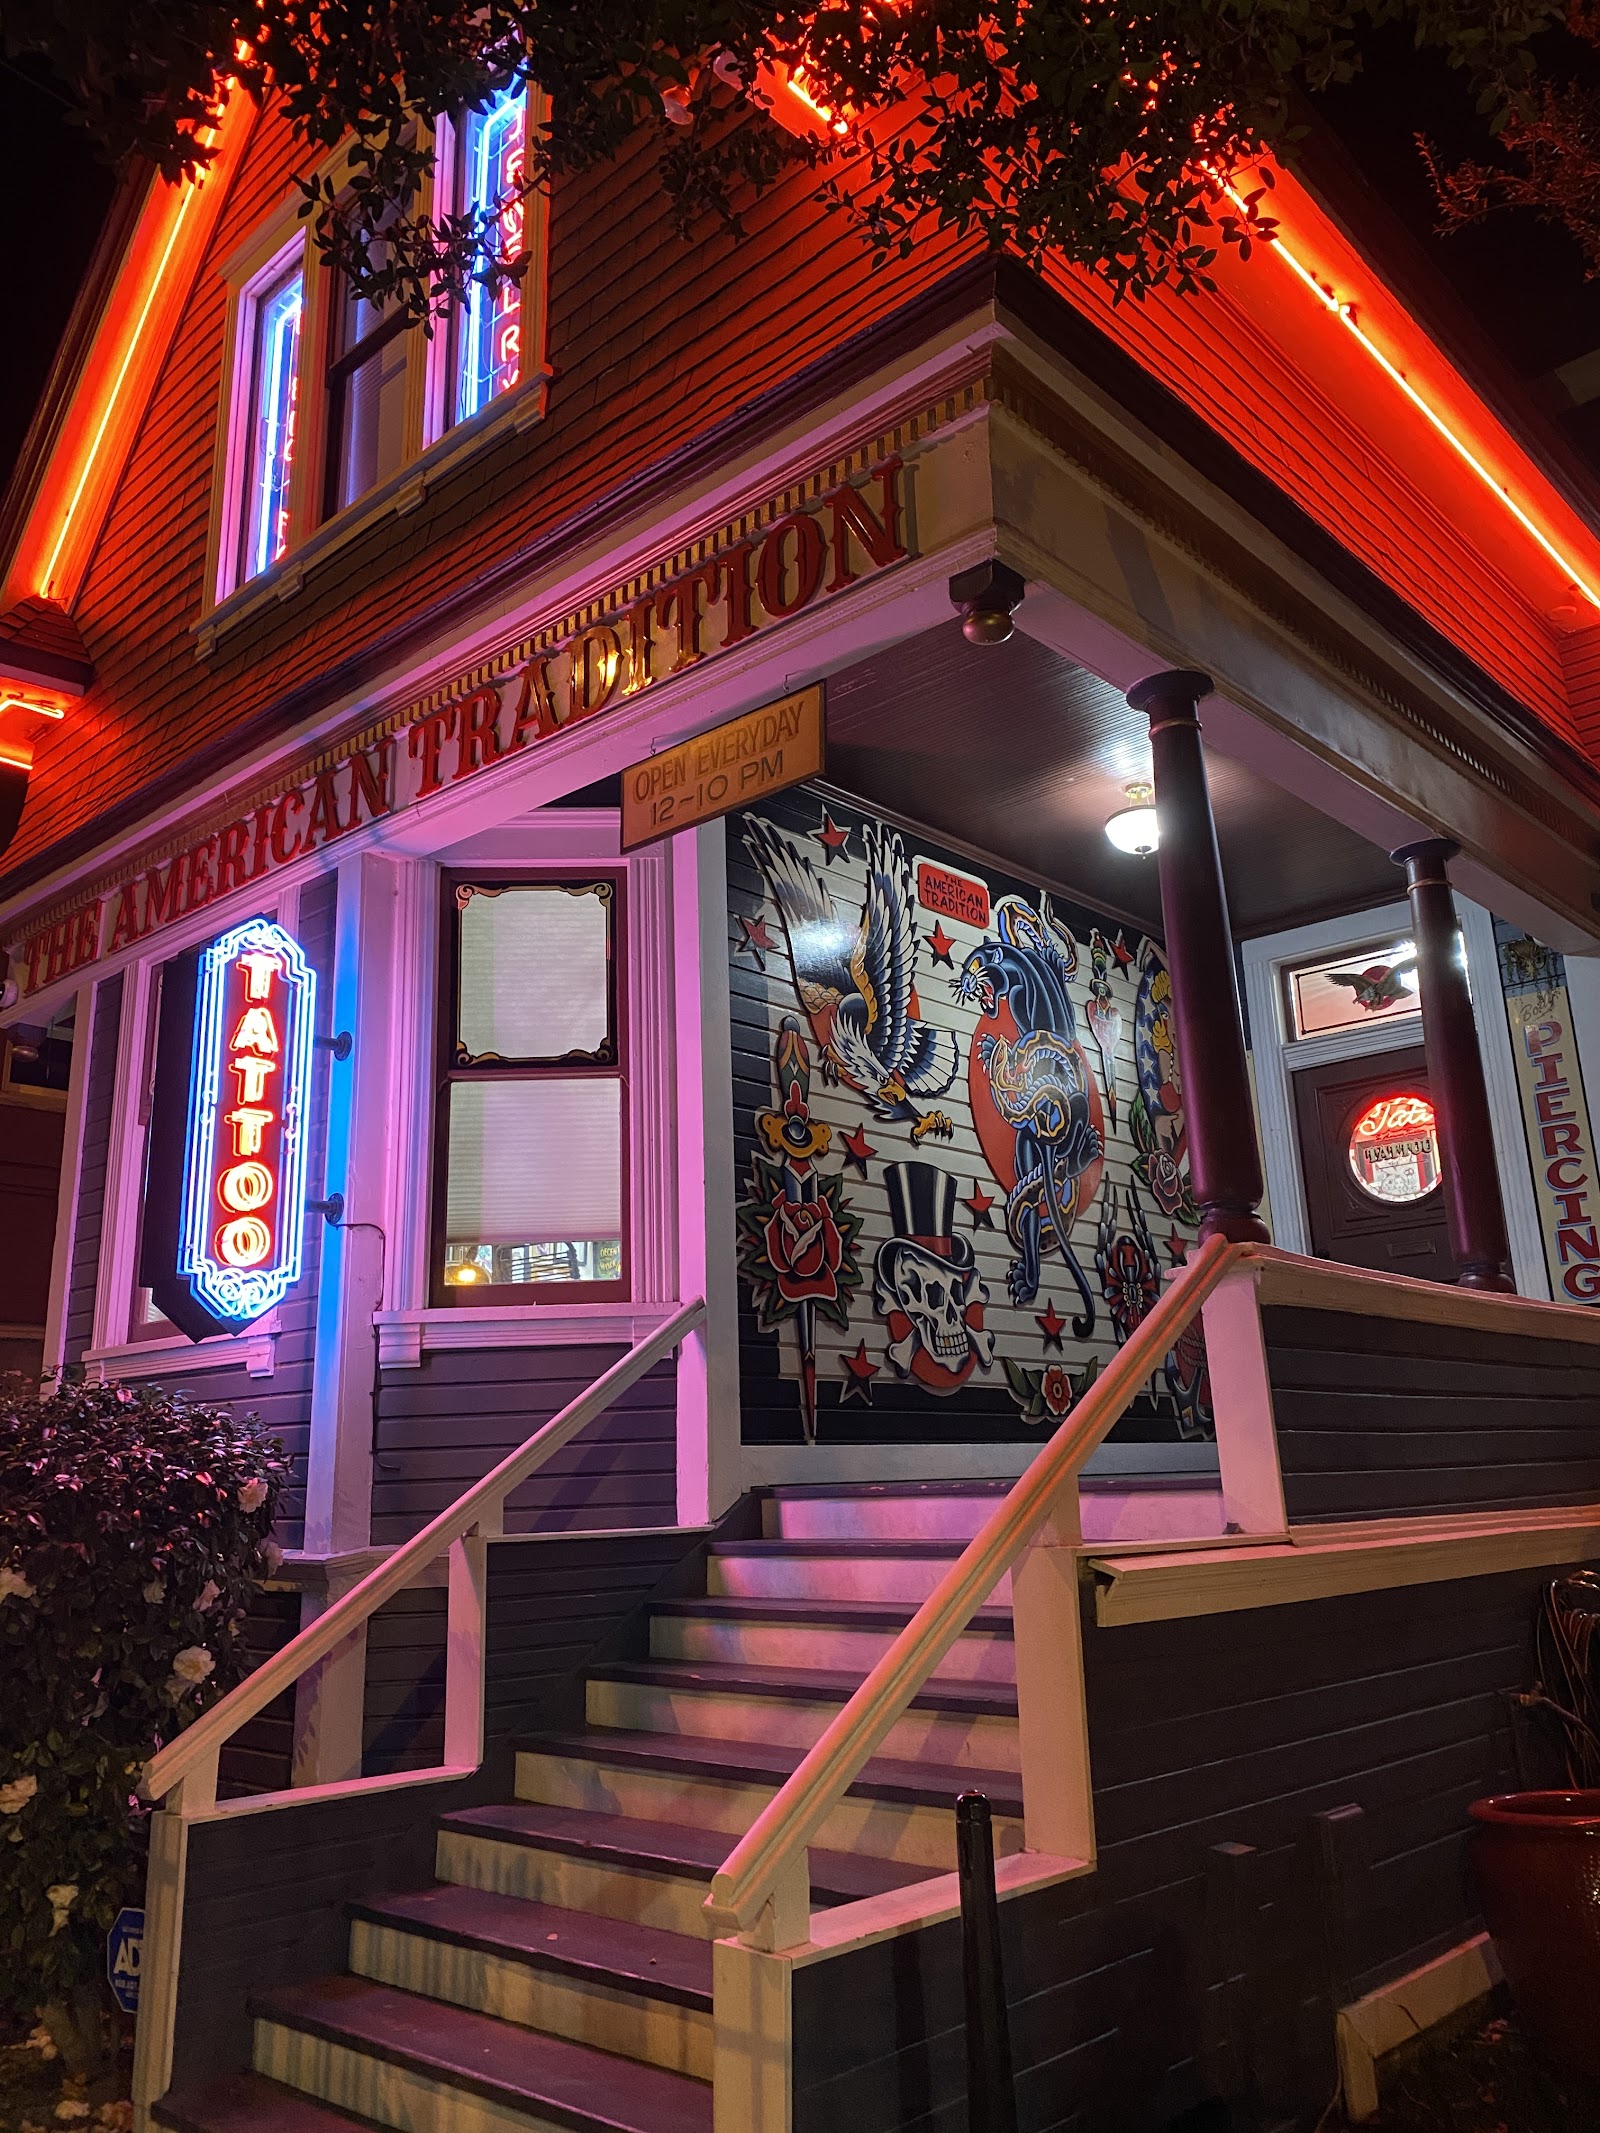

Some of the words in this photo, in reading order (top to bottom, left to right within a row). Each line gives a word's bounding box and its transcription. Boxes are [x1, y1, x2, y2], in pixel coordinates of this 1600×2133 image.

[25, 901, 100, 996] THE
[109, 738, 393, 951] AMERICAN
[409, 458, 906, 799] TRADITION
[635, 761, 686, 801] OPEN
[700, 703, 804, 774] EVERYDAY
[741, 750, 784, 788] PM
[925, 874, 983, 909] AMERICAN
[944, 873, 964, 888] THE
[924, 888, 986, 924] TRADITION
[214, 953, 282, 1267] TATTOO
[1365, 1138, 1434, 1163] TATTOO
[1523, 1021, 1600, 1300] PIERCING
[113, 1938, 141, 1977] AD
